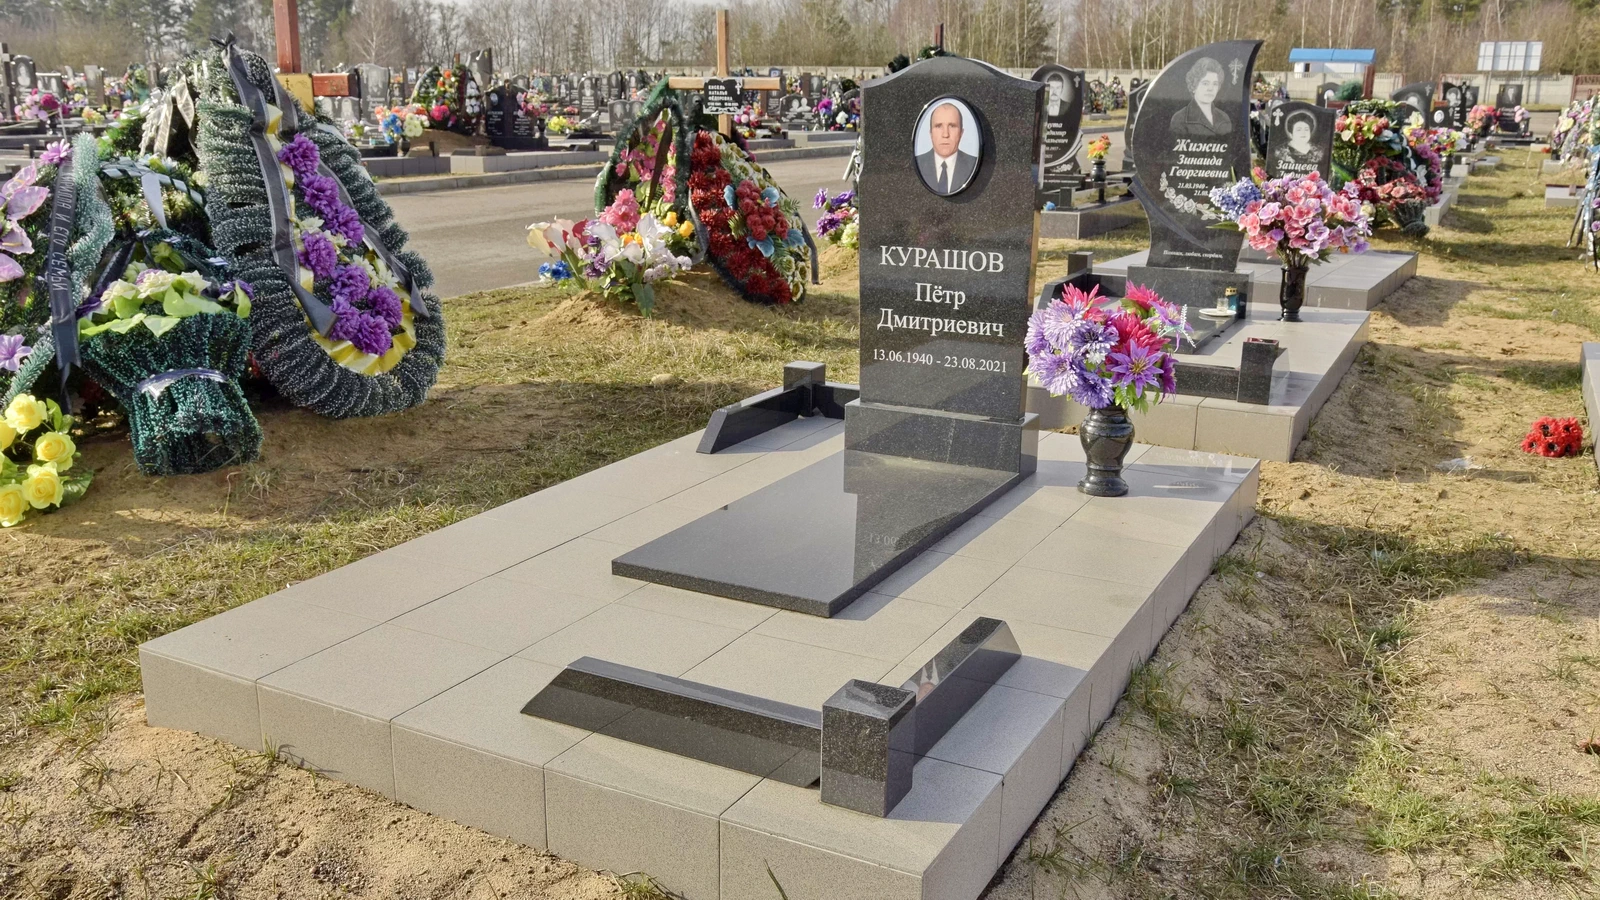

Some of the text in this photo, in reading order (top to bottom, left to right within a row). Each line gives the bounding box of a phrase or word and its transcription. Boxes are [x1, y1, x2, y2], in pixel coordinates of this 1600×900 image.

[1172, 138, 1229, 153] Жижис
[1177, 154, 1223, 166] Зинаида
[1276, 160, 1319, 172] Зайцева
[1169, 166, 1230, 179] Георгиевна
[55, 213, 71, 223] И
[53, 225, 70, 247] ЕГО
[880, 245, 1004, 273] КУРАШОВ
[51, 251, 68, 291] СЕМЬИ
[915, 282, 966, 310] Пётр
[877, 308, 1005, 337] Дмитриевич
[873, 348, 933, 366] 13.06.1940
[944, 355, 1007, 373] 23.08.2021
